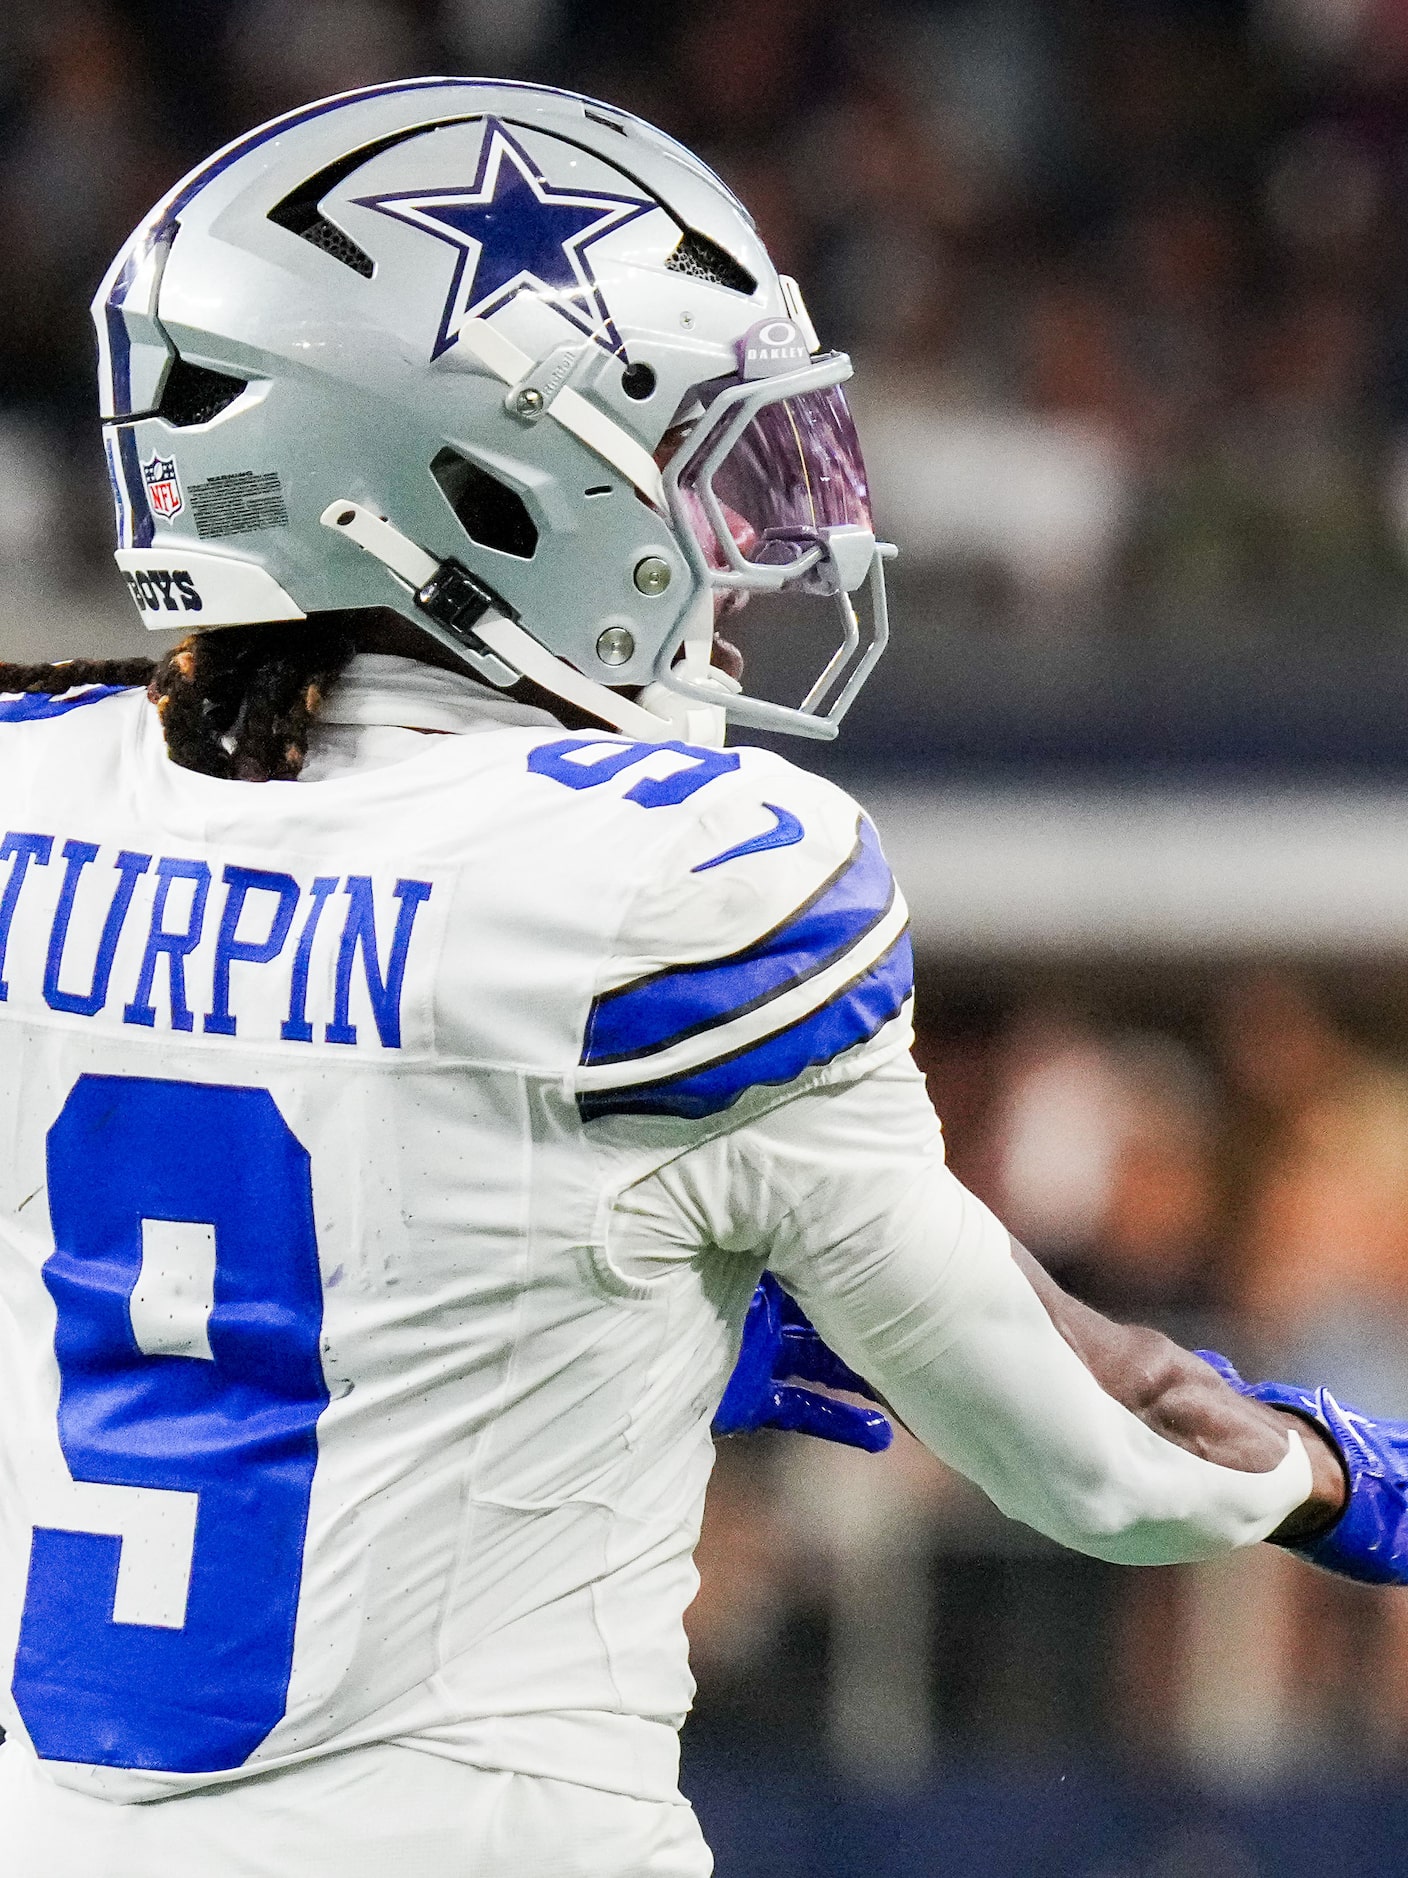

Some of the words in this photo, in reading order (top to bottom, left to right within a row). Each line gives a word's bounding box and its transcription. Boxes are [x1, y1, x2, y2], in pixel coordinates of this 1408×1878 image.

[747, 346, 804, 360] OAKLEY
[150, 482, 179, 512] NFL
[527, 739, 740, 808] 9
[0, 831, 433, 1049] TURPIN
[11, 1073, 331, 1773] 9
